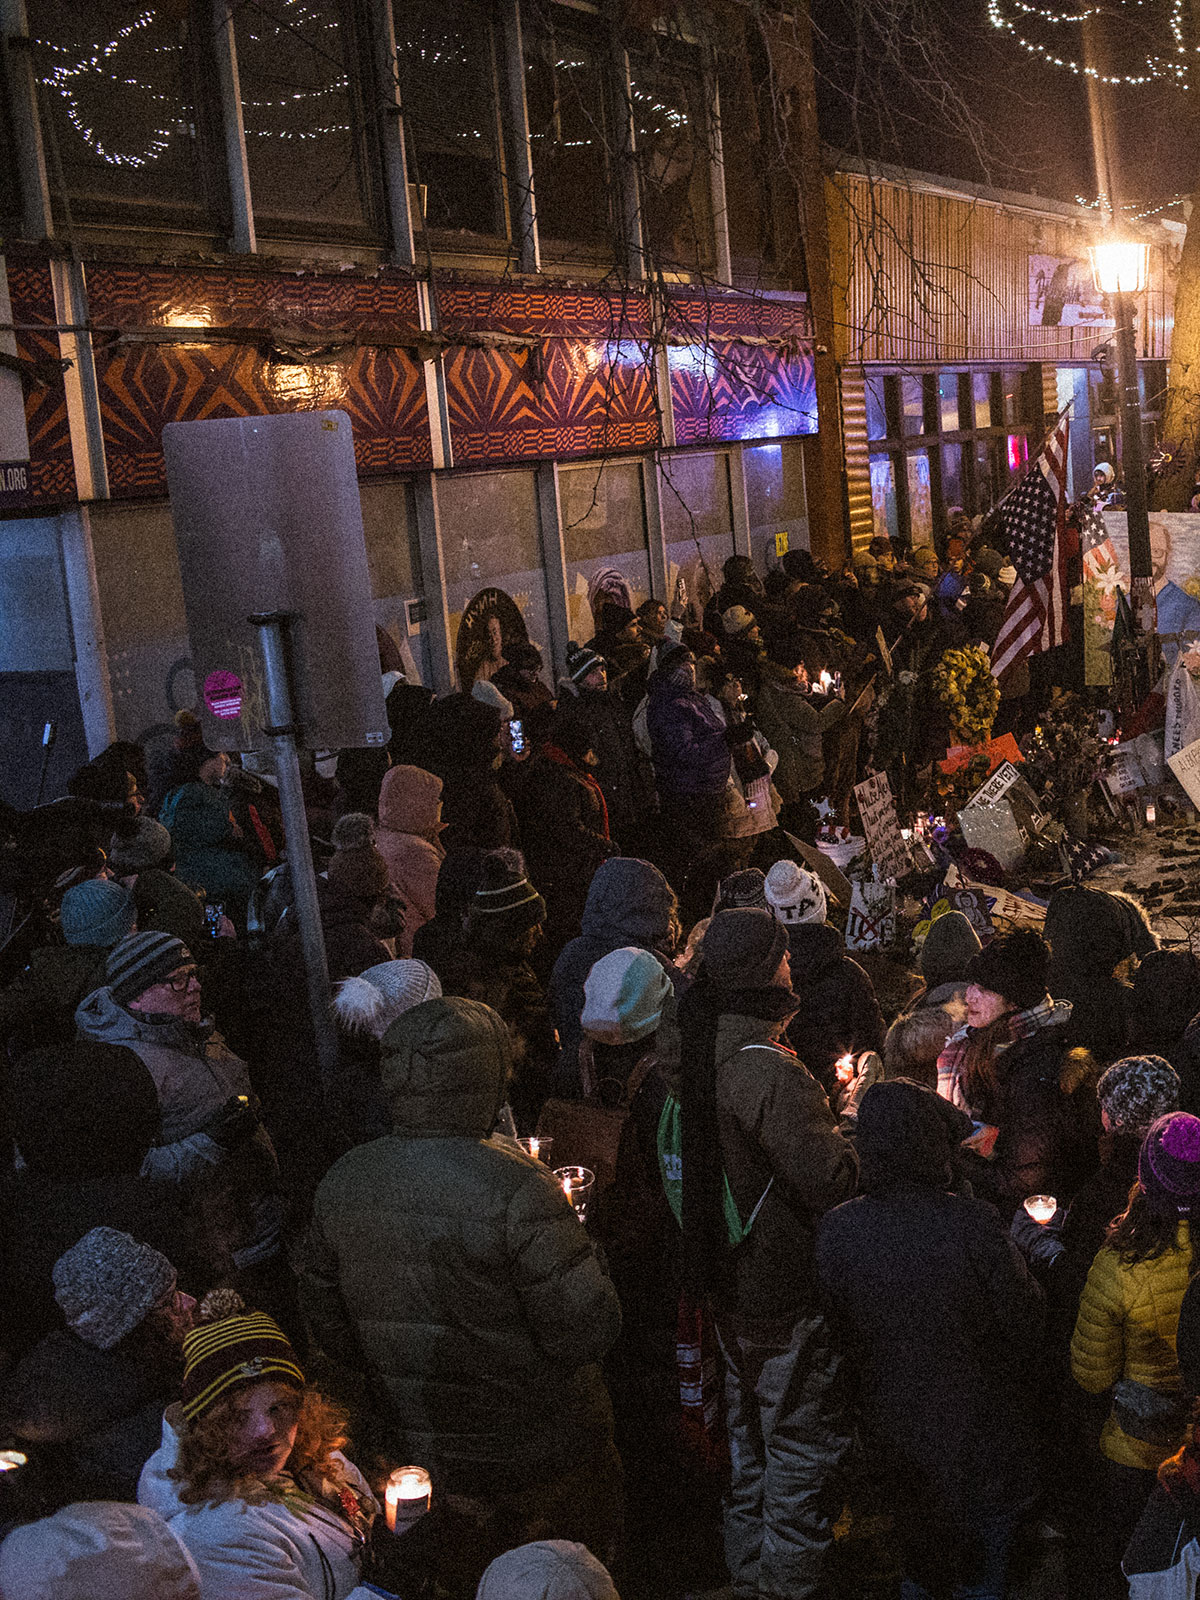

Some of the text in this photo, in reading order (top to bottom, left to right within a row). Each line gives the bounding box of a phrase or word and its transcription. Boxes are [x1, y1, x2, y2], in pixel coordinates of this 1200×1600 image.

[982, 778, 1004, 799] THERE
[997, 764, 1018, 783] YET?
[848, 912, 894, 941] ICE
